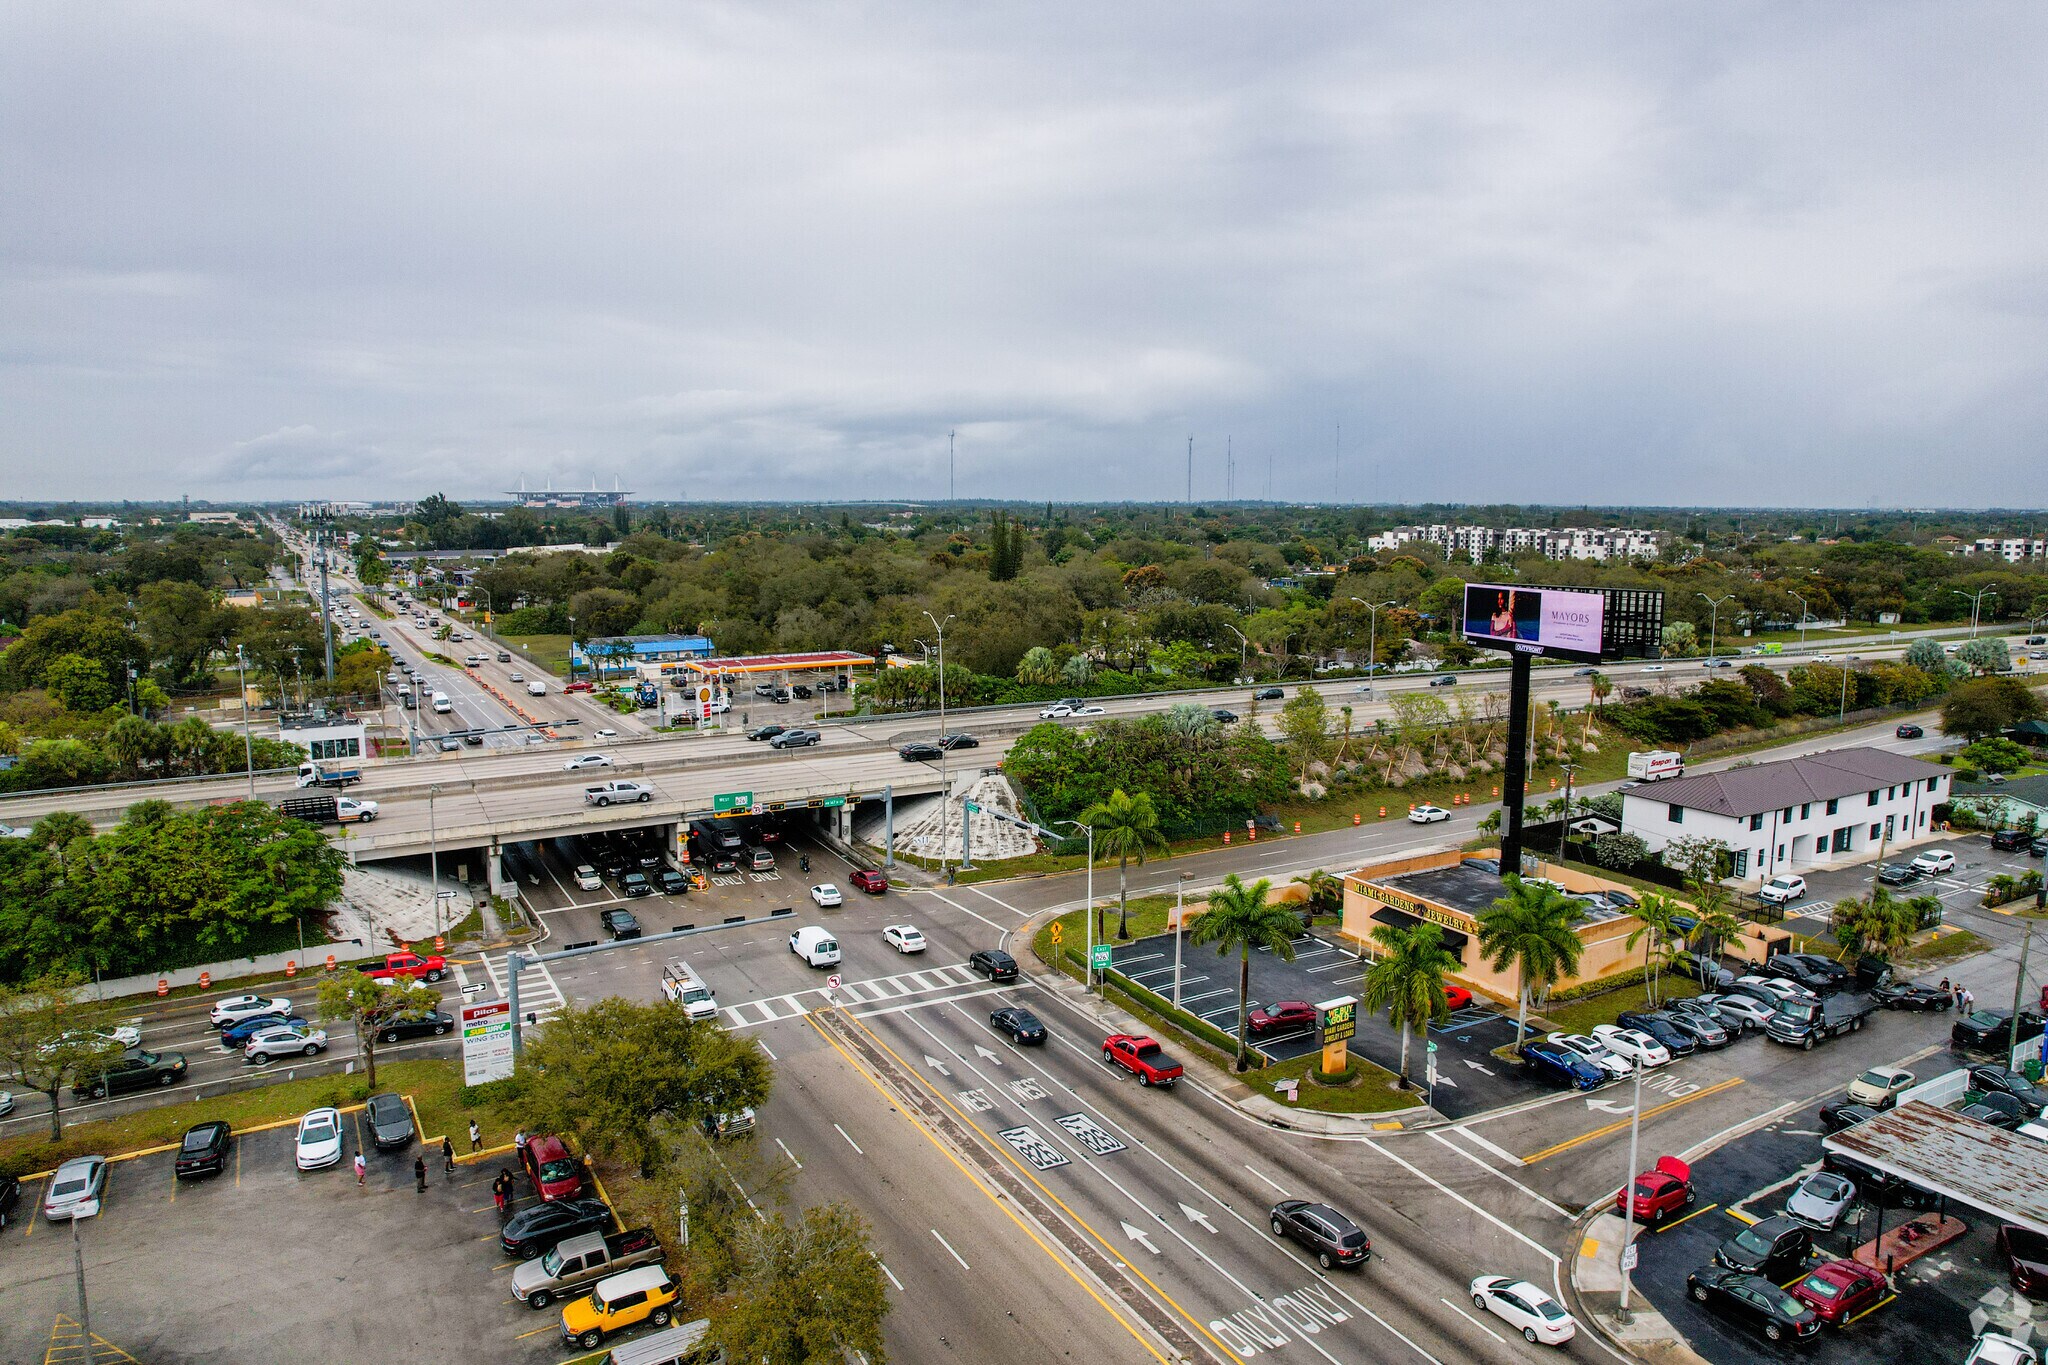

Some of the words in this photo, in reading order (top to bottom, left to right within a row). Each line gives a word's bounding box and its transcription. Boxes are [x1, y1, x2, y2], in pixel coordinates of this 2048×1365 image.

[1551, 611, 1590, 624] MAYORS
[711, 874, 746, 887] ONLY
[748, 870, 783, 883] ONLY
[1353, 882, 1378, 899] MIAMI
[1378, 891, 1416, 913] GARDENS
[1426, 909, 1465, 931] JEWELRY
[1467, 924, 1474, 933] &
[1328, 1007, 1339, 1018] WE
[1339, 1004, 1353, 1014] BUY
[1331, 1011, 1350, 1024] GOLD
[466, 1019, 488, 1028] metro
[469, 1024, 506, 1037] SUBWAY
[1324, 1026, 1336, 1035] MIAMI
[1337, 1021, 1355, 1032] GARDENS
[466, 1036, 488, 1044] WING
[490, 1031, 511, 1041] STOP
[1343, 1028, 1355, 1038] LOANS
[1004, 1077, 1053, 1101] WEST
[1634, 1072, 1701, 1098] ONLY
[952, 1088, 1000, 1113] WEST
[1075, 1128, 1117, 1152] 826
[1019, 1141, 1060, 1166] 826
[1272, 1283, 1354, 1334] ONLY
[1209, 1305, 1292, 1357] ONLY
